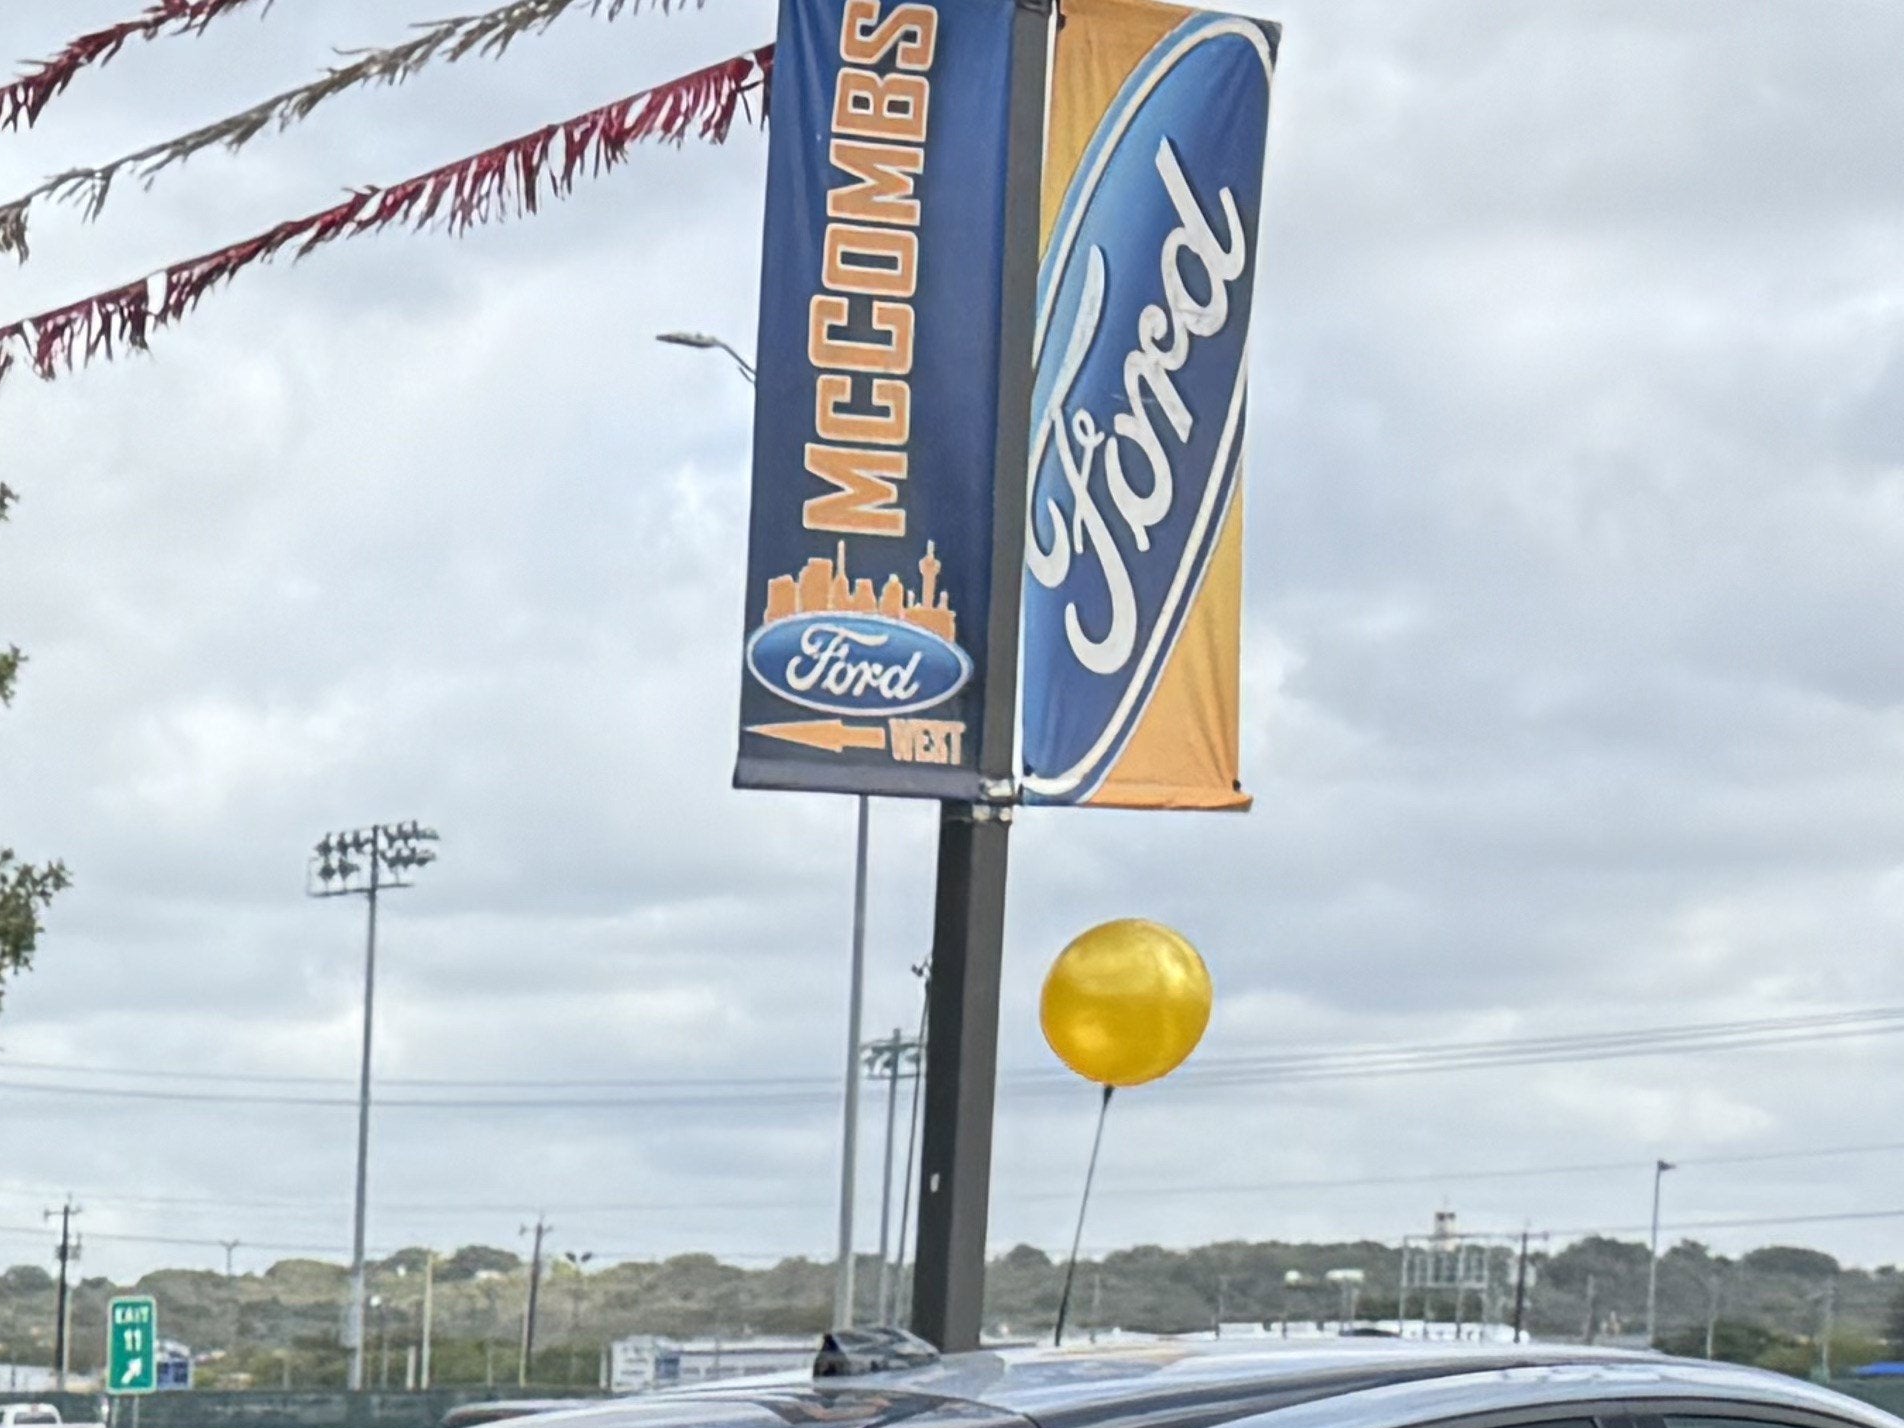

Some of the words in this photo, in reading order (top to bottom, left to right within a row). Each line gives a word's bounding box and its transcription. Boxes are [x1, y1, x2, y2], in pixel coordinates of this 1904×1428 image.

[804, 0, 939, 536] MCCOMBS
[1028, 136, 1246, 675] Ford
[786, 623, 923, 700] Ford
[888, 718, 966, 765] WEST
[123, 1328, 142, 1352] 11
